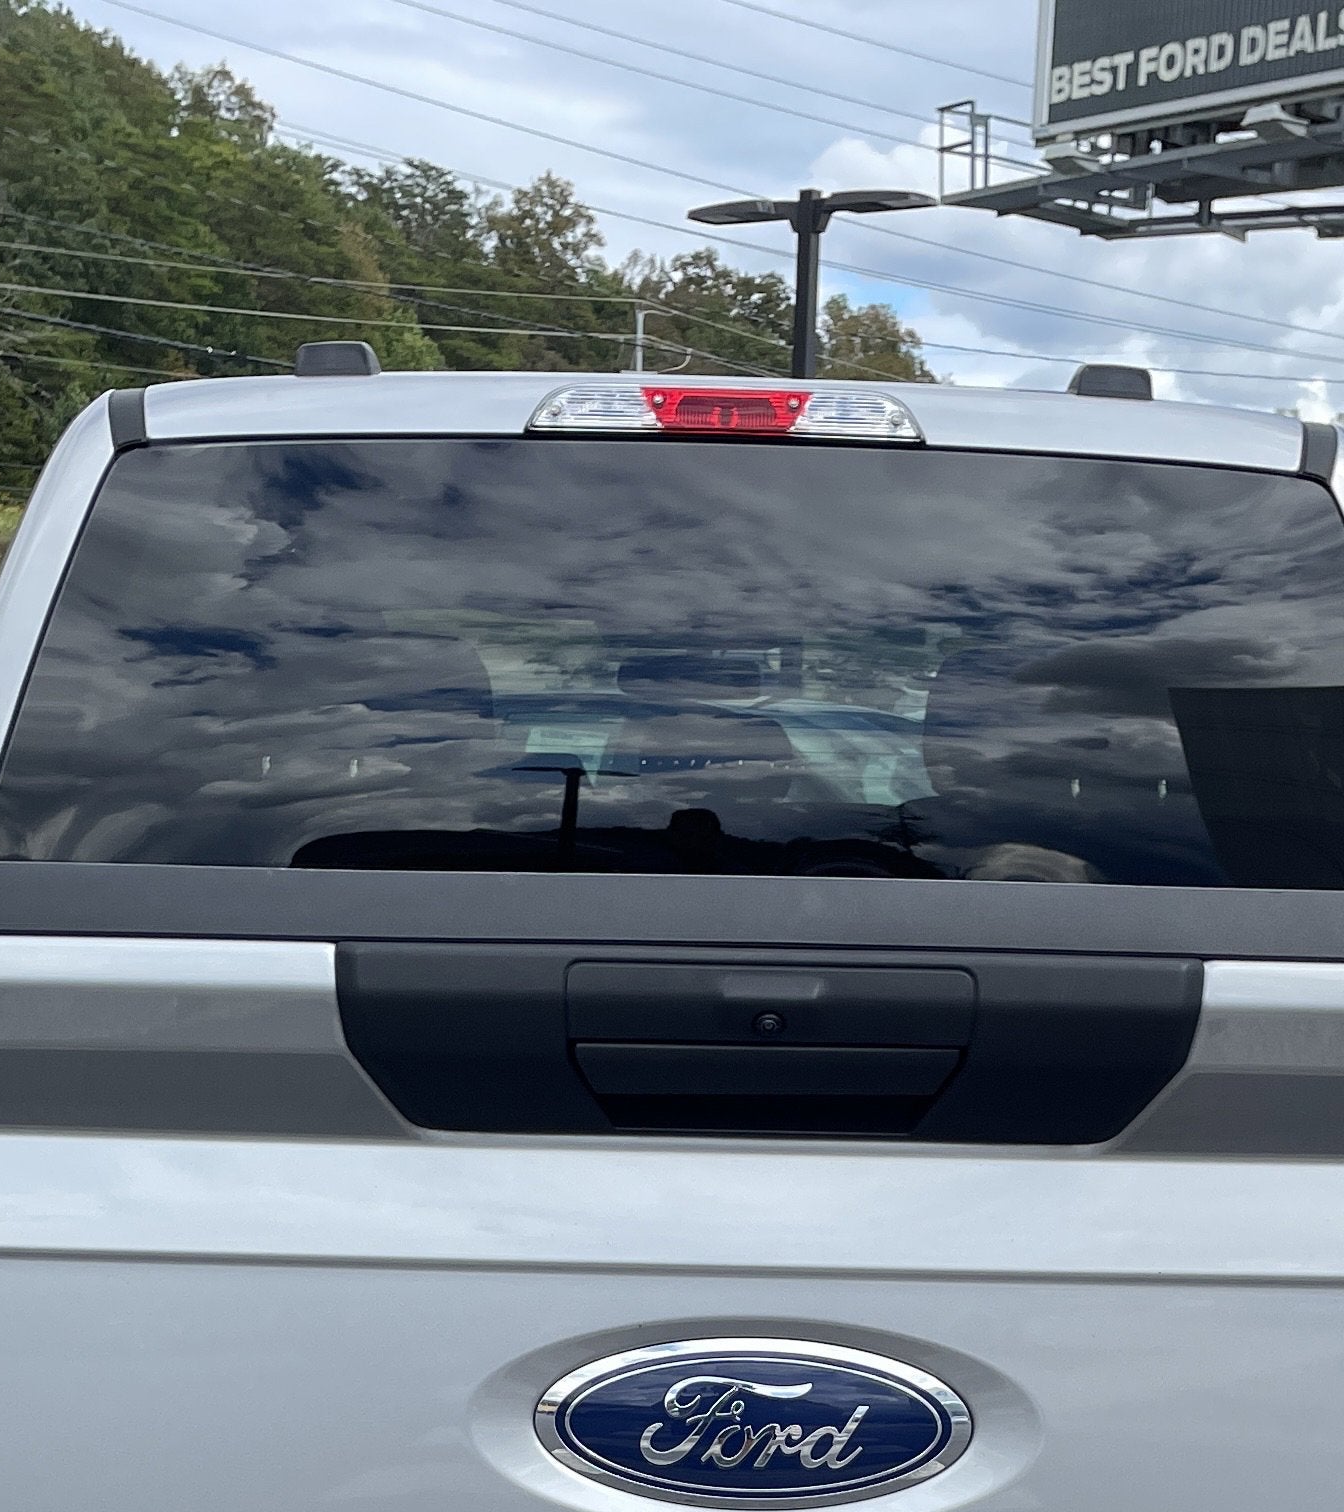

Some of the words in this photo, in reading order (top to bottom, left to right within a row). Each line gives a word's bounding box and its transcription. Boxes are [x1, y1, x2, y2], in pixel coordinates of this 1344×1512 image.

[1050, 50, 1134, 104] BEST
[1137, 32, 1234, 87] FORD
[640, 1375, 870, 1469] Ford
